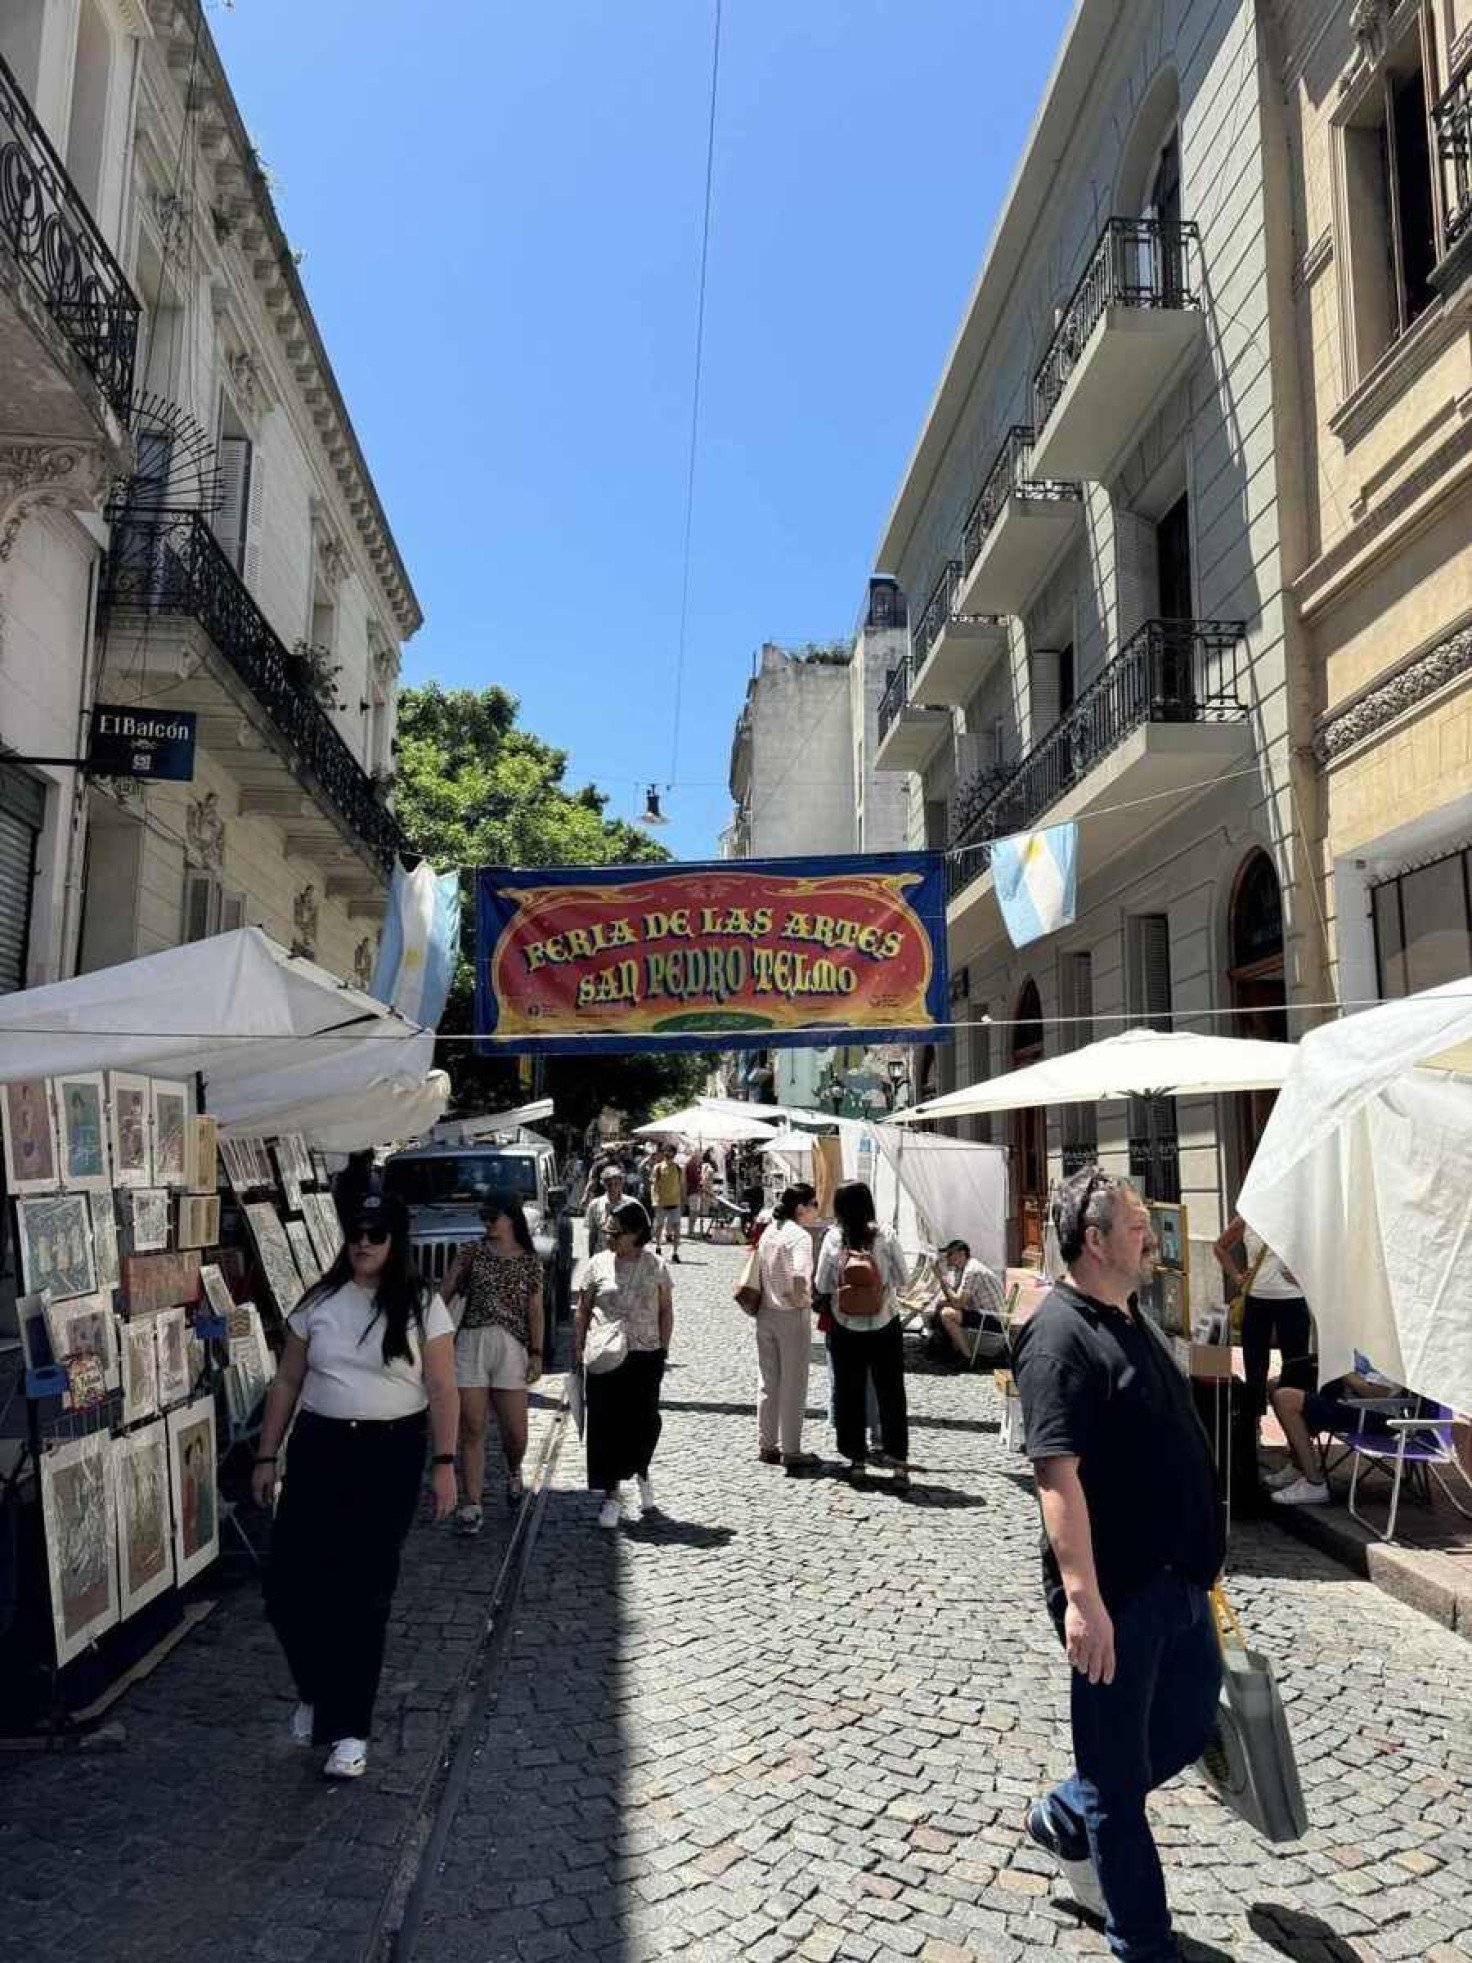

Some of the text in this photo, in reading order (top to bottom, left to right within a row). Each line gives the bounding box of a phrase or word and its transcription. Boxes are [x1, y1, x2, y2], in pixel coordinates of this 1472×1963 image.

[101, 714, 189, 740] El Balcón
[523, 907, 905, 973] FERIA DE LAS ARTES
[578, 945, 858, 1007] SAN PEDRO TELMO
